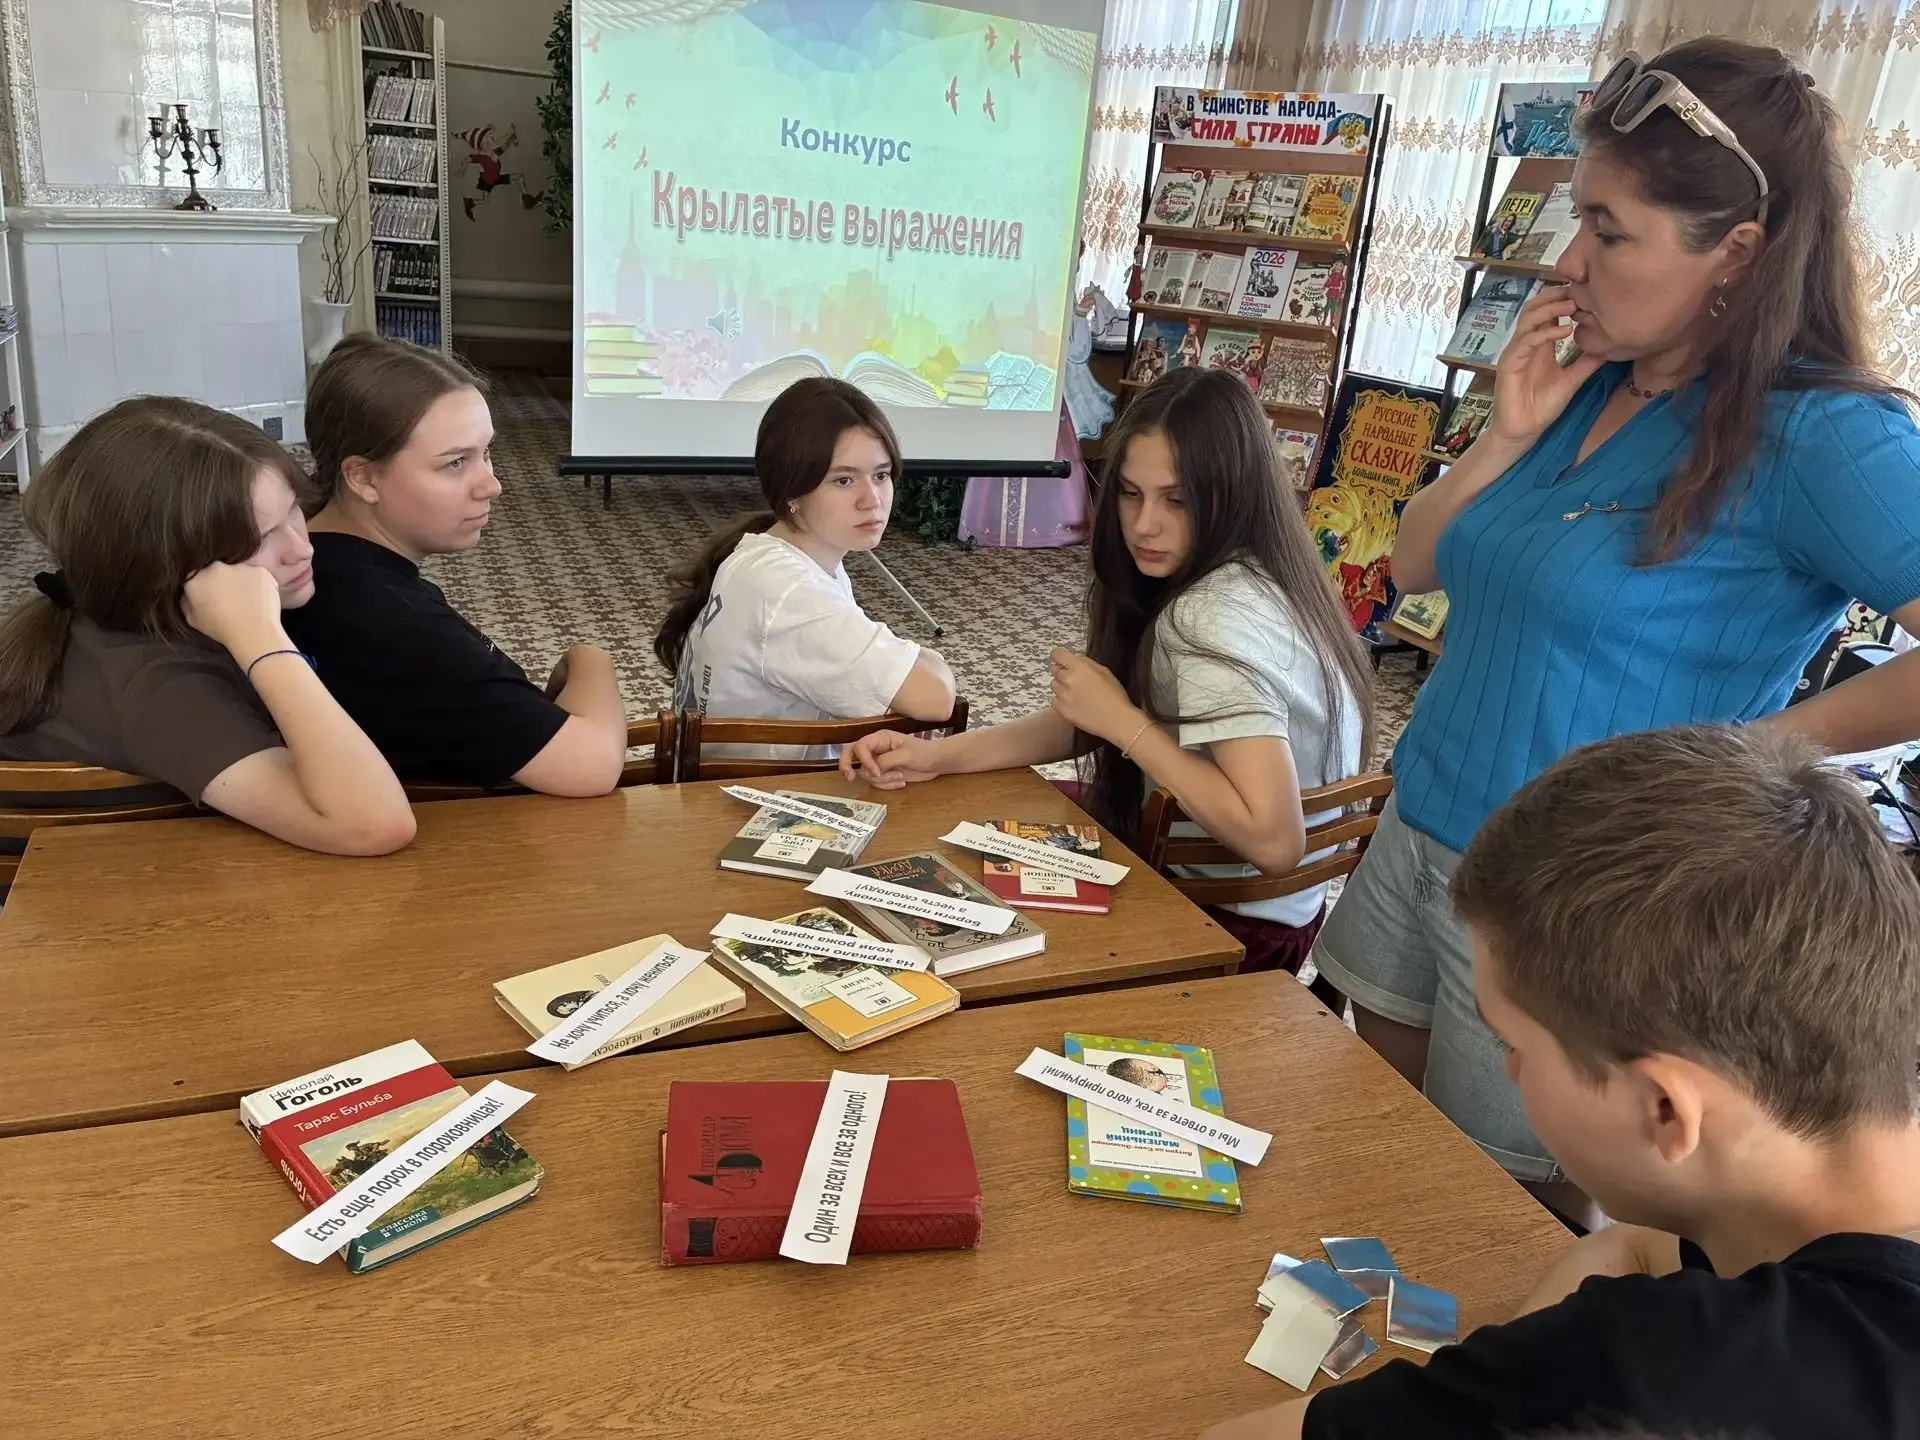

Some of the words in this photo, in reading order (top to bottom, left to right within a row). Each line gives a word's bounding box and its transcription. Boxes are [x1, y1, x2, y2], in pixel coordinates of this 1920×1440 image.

[1187, 95, 1195, 112] В
[1203, 96, 1270, 116] ЕДИНСТВЕ
[1190, 117, 1238, 141] СИЛА
[1247, 121, 1321, 146] СТРАНЫ
[779, 115, 912, 168] Конкурс
[651, 168, 836, 242] Крылатые
[842, 201, 1024, 261] выражения
[1255, 250, 1286, 265] 2026
[1372, 405, 1419, 429] РУССКИЕ
[1362, 422, 1418, 448] НАРОДНЫЕ
[1350, 439, 1417, 477] СКАЗКИ
[1352, 466, 1382, 482] БОЛЬШАЯ
[1381, 474, 1401, 488] КНИГА
[990, 845, 1022, 858] петуха
[1042, 852, 1075, 865] хвалит
[1023, 854, 1057, 867] хвалит
[1075, 861, 1093, 869] что
[1057, 863, 1101, 880] Кукушка
[844, 888, 884, 904] снову,
[855, 883, 918, 902] смолоду!
[886, 900, 932, 914] платье
[920, 897, 956, 911] честь
[933, 911, 981, 928] Береги
[740, 931, 793, 946] пенять,
[772, 927, 814, 941] крива
[818, 936, 856, 948] рожа
[795, 942, 831, 953] неча
[833, 947, 893, 963] зеркало
[858, 943, 895, 954] коли
[896, 959, 916, 968] На
[548, 1037, 575, 1050] Не
[565, 1022, 597, 1041] хочу
[583, 1000, 628, 1027] учиться,
[620, 980, 651, 998] хочу
[637, 951, 681, 984] жениться!
[269, 1072, 335, 1102] Николай
[1040, 1064, 1107, 1095] приручили!
[274, 1074, 363, 1112] Гоголь
[1106, 1088, 1132, 1105] кого
[294, 1111, 340, 1133] Тарас
[340, 1091, 394, 1118] Бульба
[842, 1089, 868, 1127] одного!
[1134, 1097, 1154, 1115] тех,
[1155, 1107, 1171, 1119] за
[1120, 1125, 1163, 1138] ПРИНЦ
[1170, 1113, 1207, 1134] ответе
[838, 1128, 858, 1140] за
[1105, 1133, 1180, 1148] МАЛЕНЬКИЙ
[1208, 1129, 1218, 1138] в
[1217, 1131, 1241, 1149] Мы
[832, 1140, 855, 1158] все
[304, 1216, 347, 1243] Есть
[340, 1193, 376, 1219] еще
[368, 1163, 415, 1198] порох
[406, 1156, 423, 1169] в
[415, 1096, 505, 1162] пороховницах!
[830, 1158, 850, 1167] и
[823, 1167, 848, 1192] всех
[819, 1192, 841, 1207] за
[379, 1209, 428, 1234] классика
[394, 1214, 429, 1233] школе
[803, 1208, 840, 1244] Один
